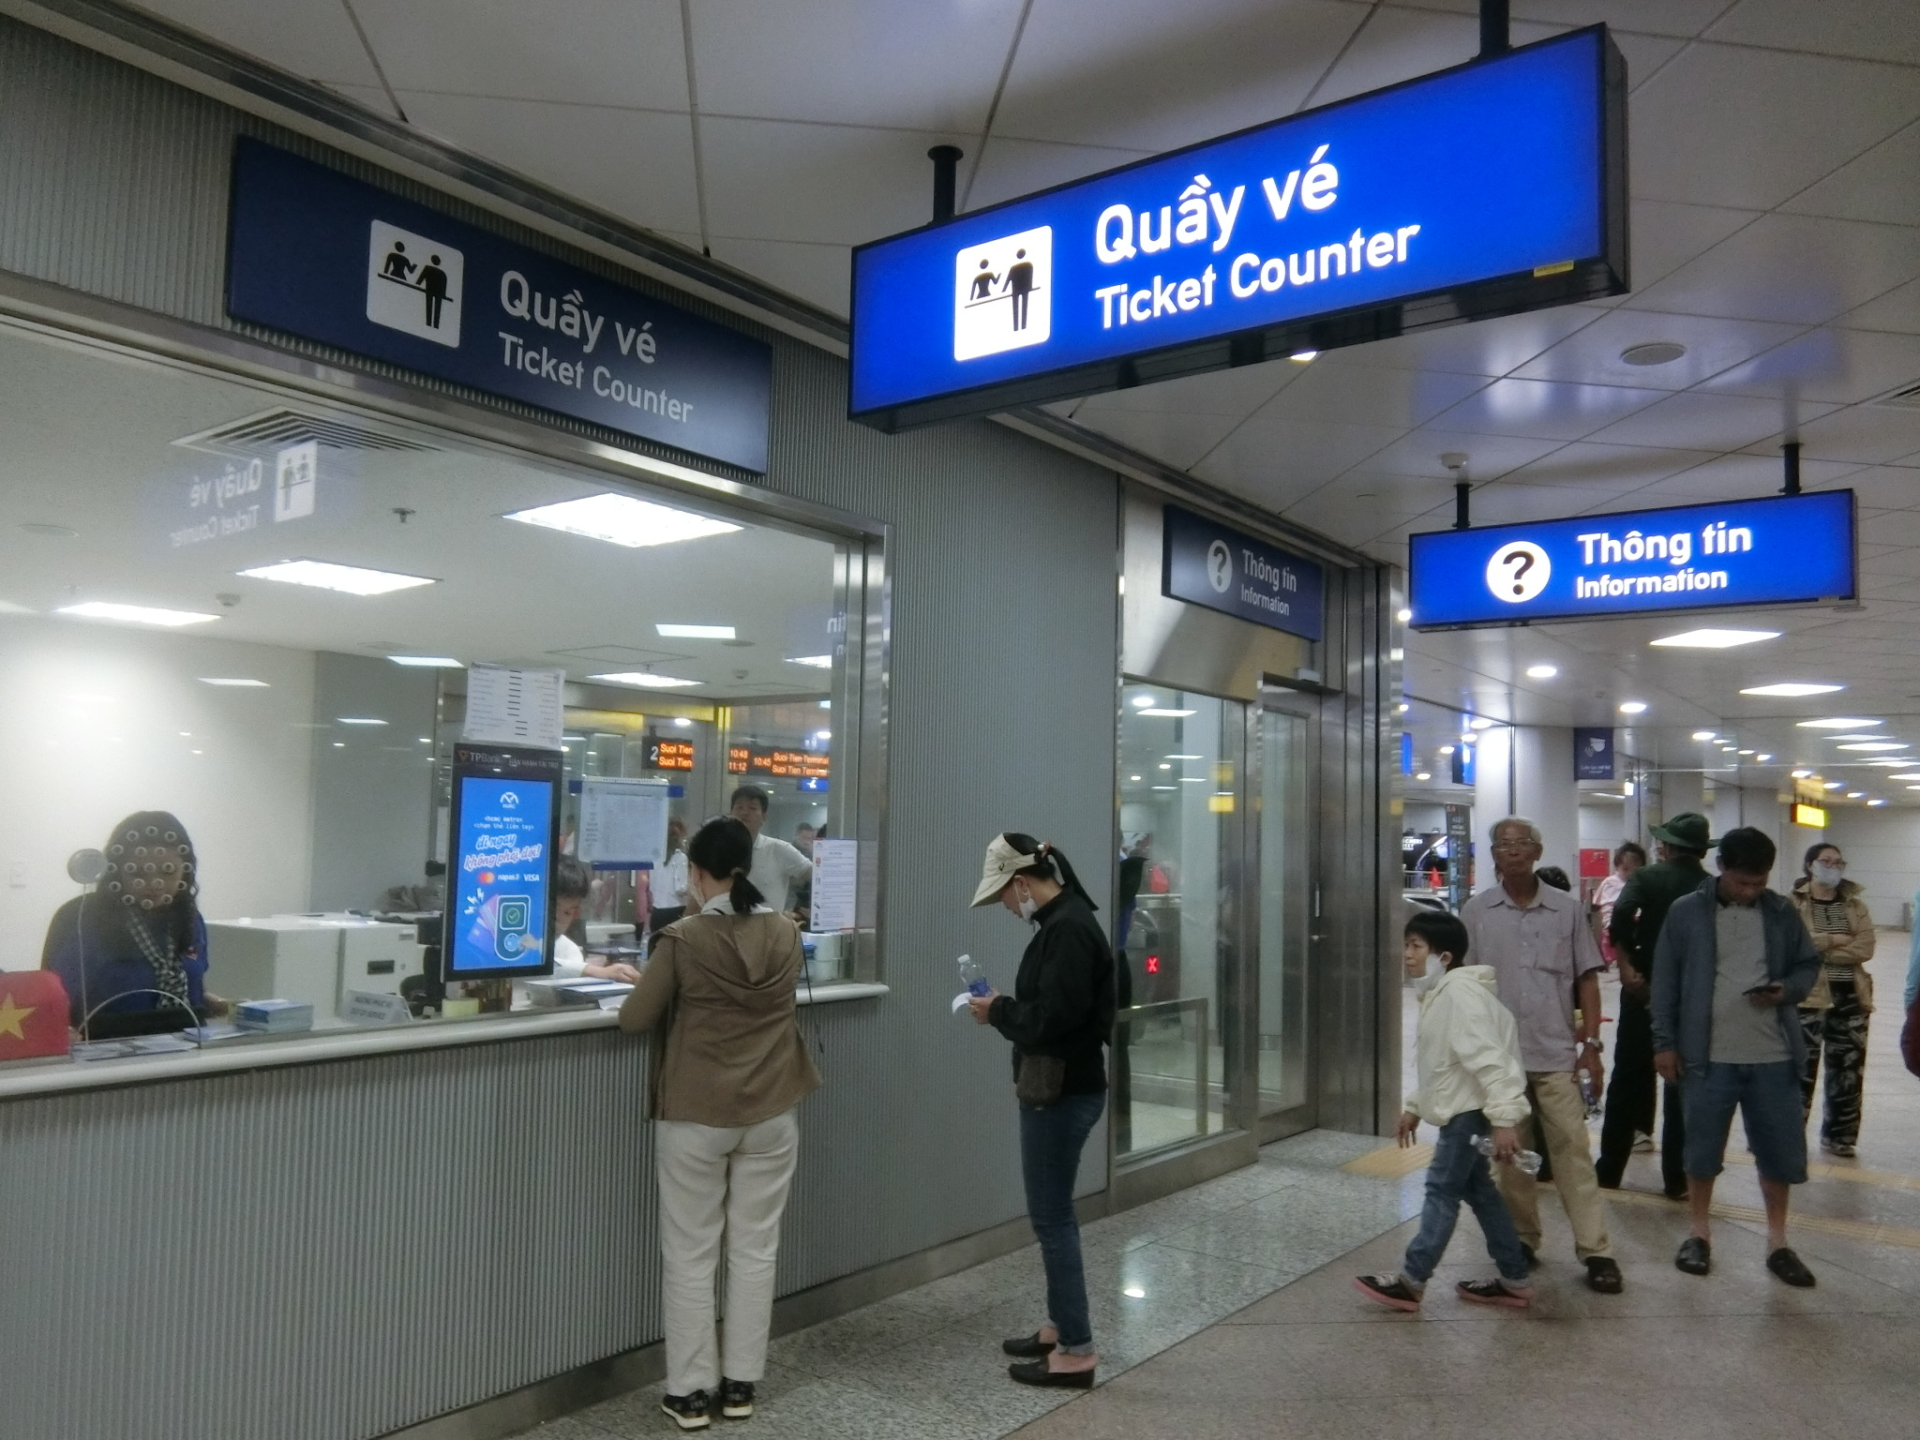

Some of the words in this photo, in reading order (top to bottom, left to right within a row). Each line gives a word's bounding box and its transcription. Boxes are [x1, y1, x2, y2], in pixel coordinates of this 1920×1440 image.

[1095, 173, 1244, 266] Quầy
[1262, 143, 1339, 221] vé
[1095, 263, 1217, 329] Ticket
[1229, 223, 1421, 298] Counter
[499, 270, 605, 355] Quầy
[615, 319, 657, 365] vé
[498, 331, 584, 391] Ticket
[592, 364, 694, 425] Counter
[1577, 530, 1692, 567] Thông
[1702, 521, 1752, 554] tin
[1242, 549, 1280, 591] Thông
[1282, 565, 1297, 592] tin
[1577, 569, 1728, 600] Information
[1241, 583, 1290, 616] Information
[650, 745, 659, 761] 2
[677, 757, 692, 767] Tien
[678, 744, 693, 755] Tien
